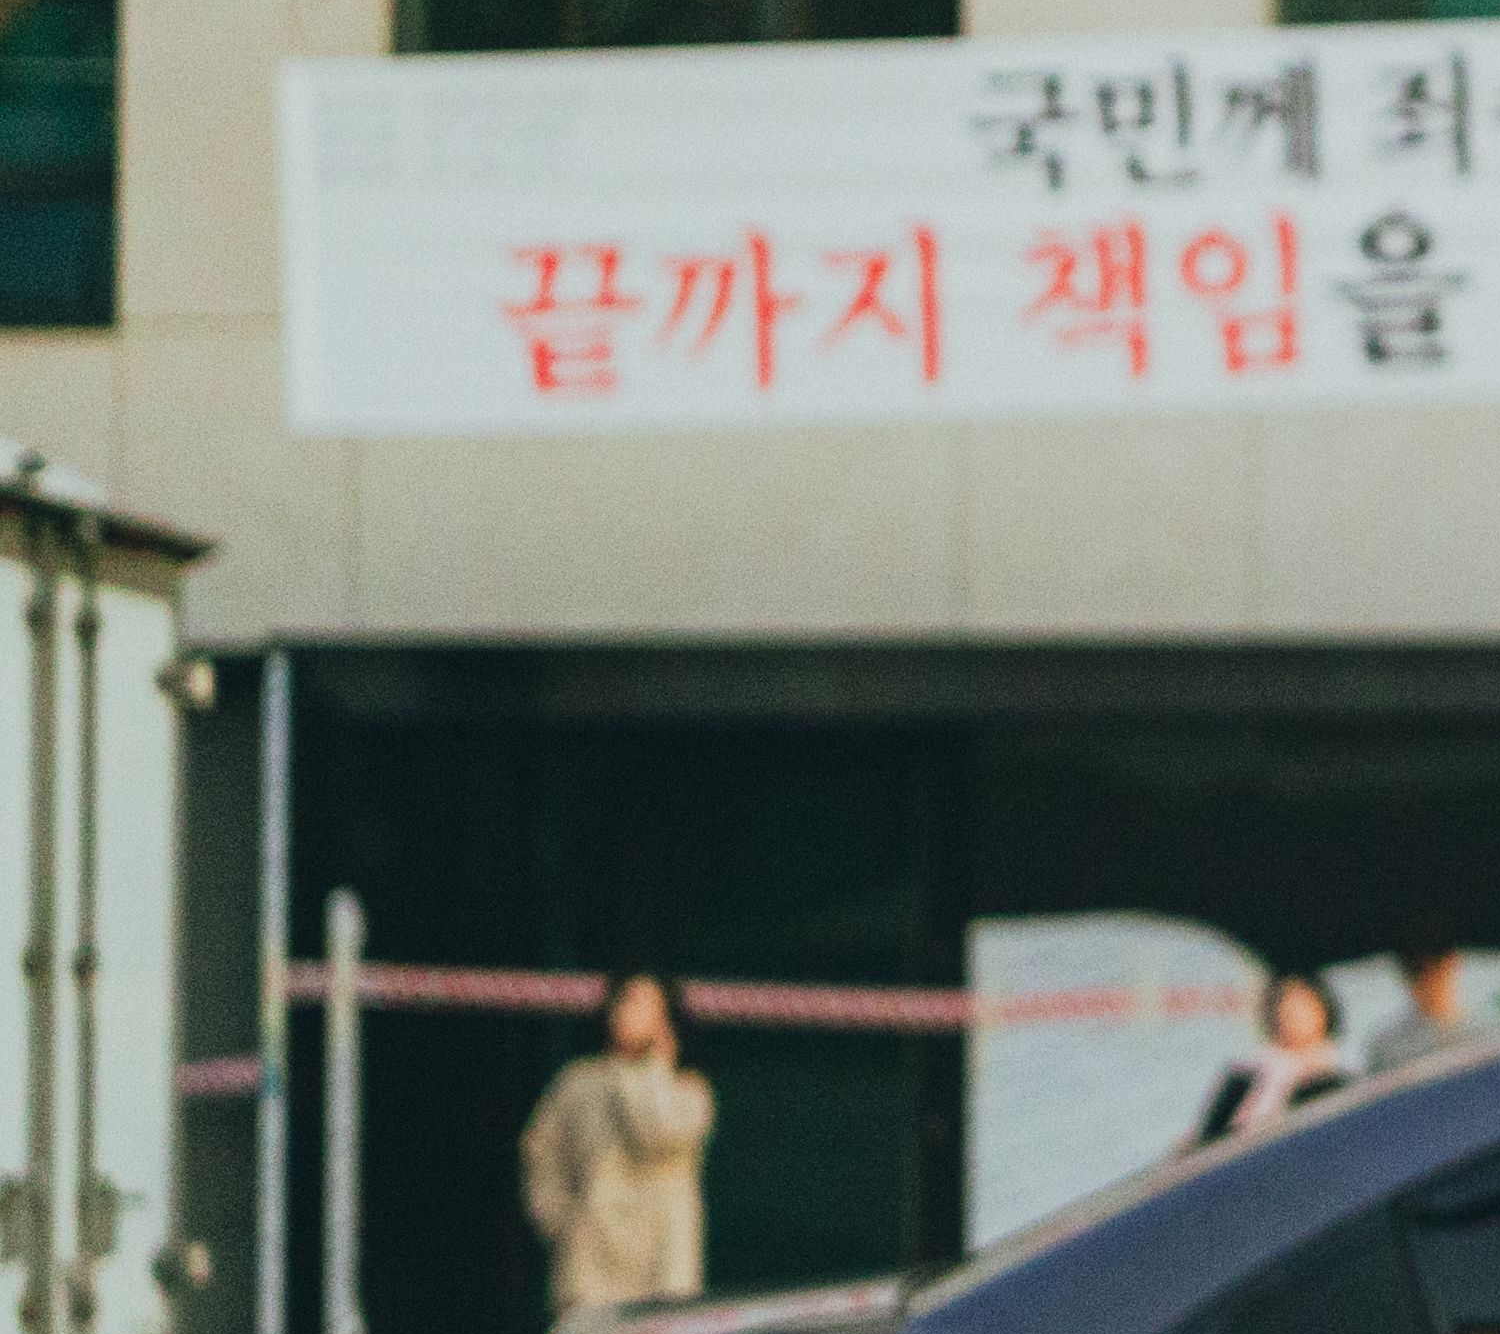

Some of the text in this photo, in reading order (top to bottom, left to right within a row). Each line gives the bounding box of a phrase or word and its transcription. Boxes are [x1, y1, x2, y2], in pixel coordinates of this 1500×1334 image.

[973, 55, 1325, 195] 국민께
[504, 222, 944, 396] 끝까지
[1026, 203, 1470, 381] 책임을
